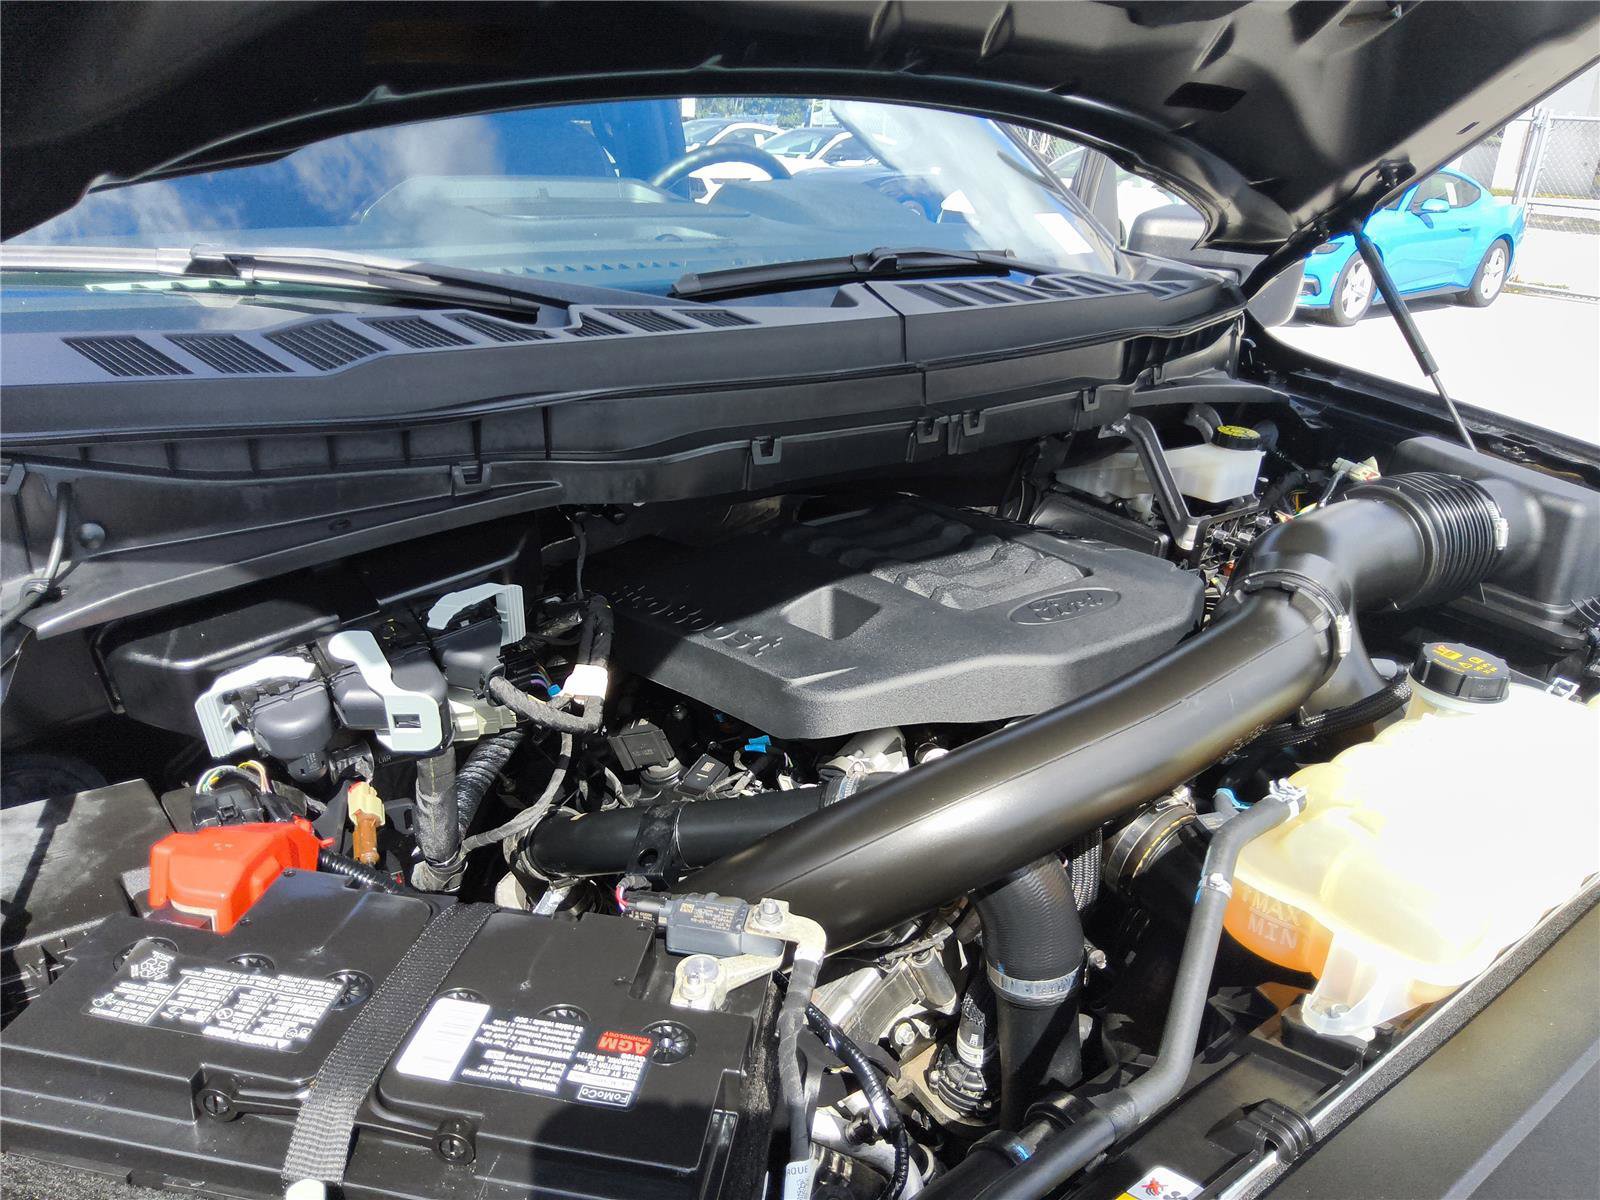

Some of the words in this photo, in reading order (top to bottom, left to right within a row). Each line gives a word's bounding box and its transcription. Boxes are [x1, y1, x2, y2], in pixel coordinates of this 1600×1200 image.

[1027, 592, 1104, 621] Ford
[1251, 893, 1301, 926] MAX
[1248, 913, 1297, 949] MIN
[598, 1036, 649, 1054] AGM
[603, 1031, 651, 1043] TECHNOLOGY
[581, 1088, 628, 1102] FoMoCo
